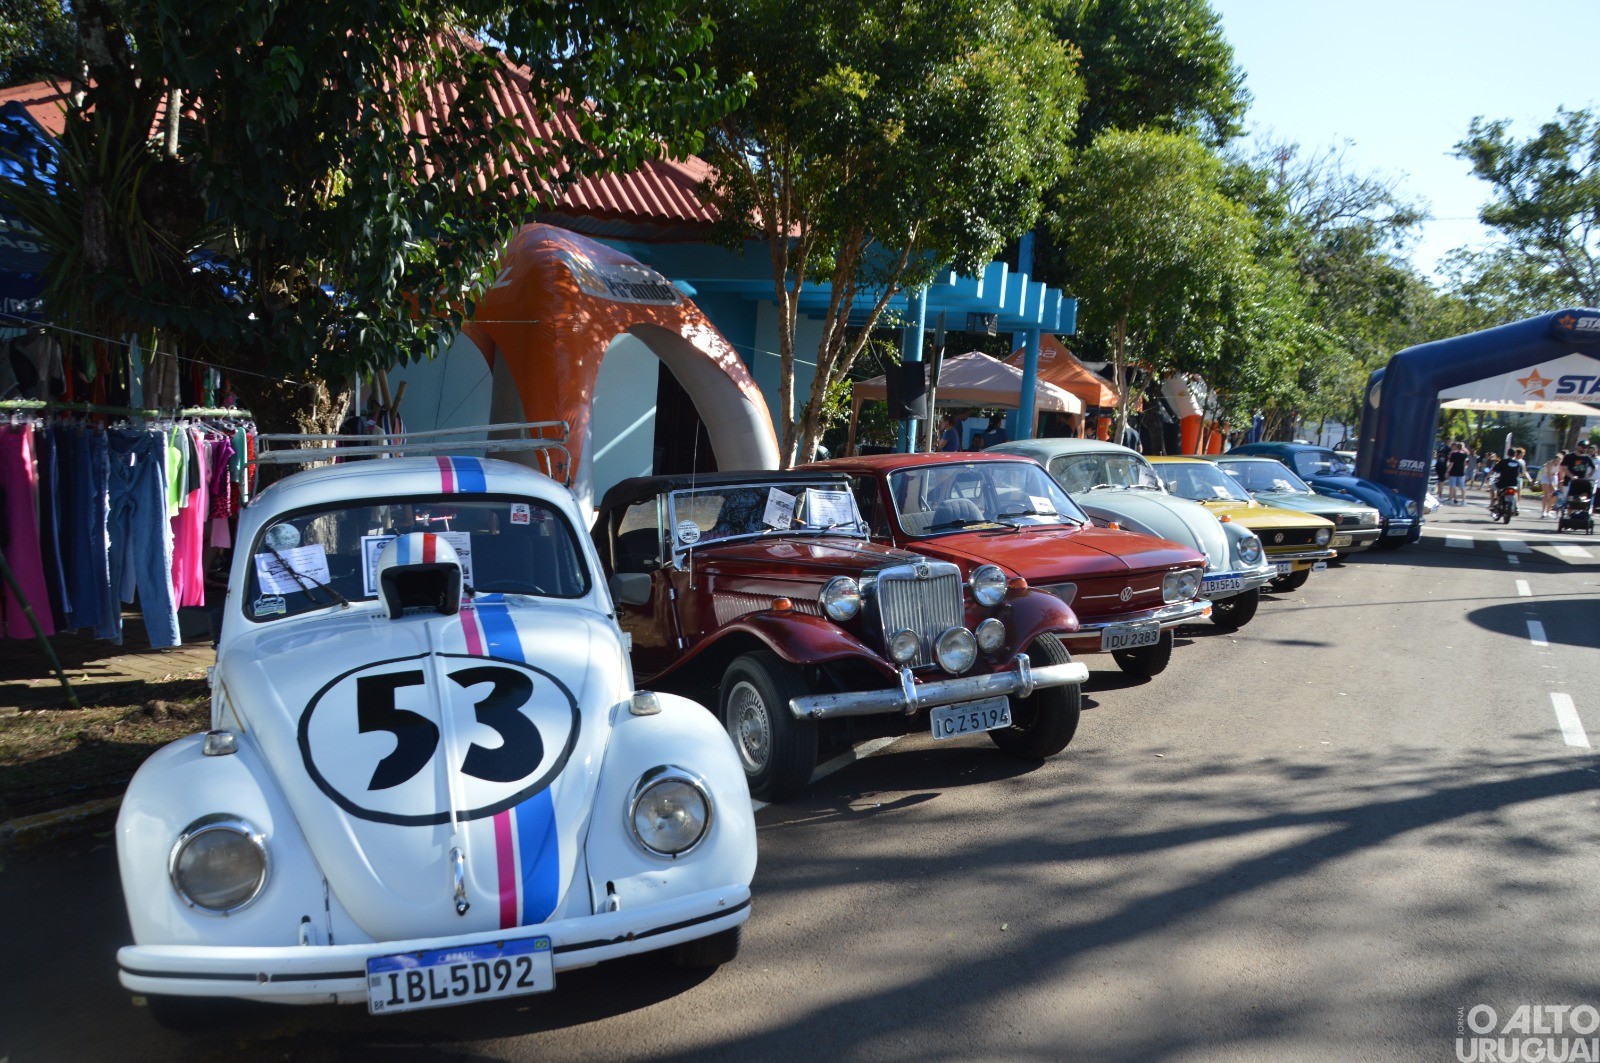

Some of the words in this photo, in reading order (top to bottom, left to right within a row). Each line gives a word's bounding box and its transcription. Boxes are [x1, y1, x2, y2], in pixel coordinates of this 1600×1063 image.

[1398, 459, 1425, 470] STAR
[357, 666, 544, 791] 53
[386, 956, 534, 1006] IBL5D92
[374, 1000, 385, 1011] BR
